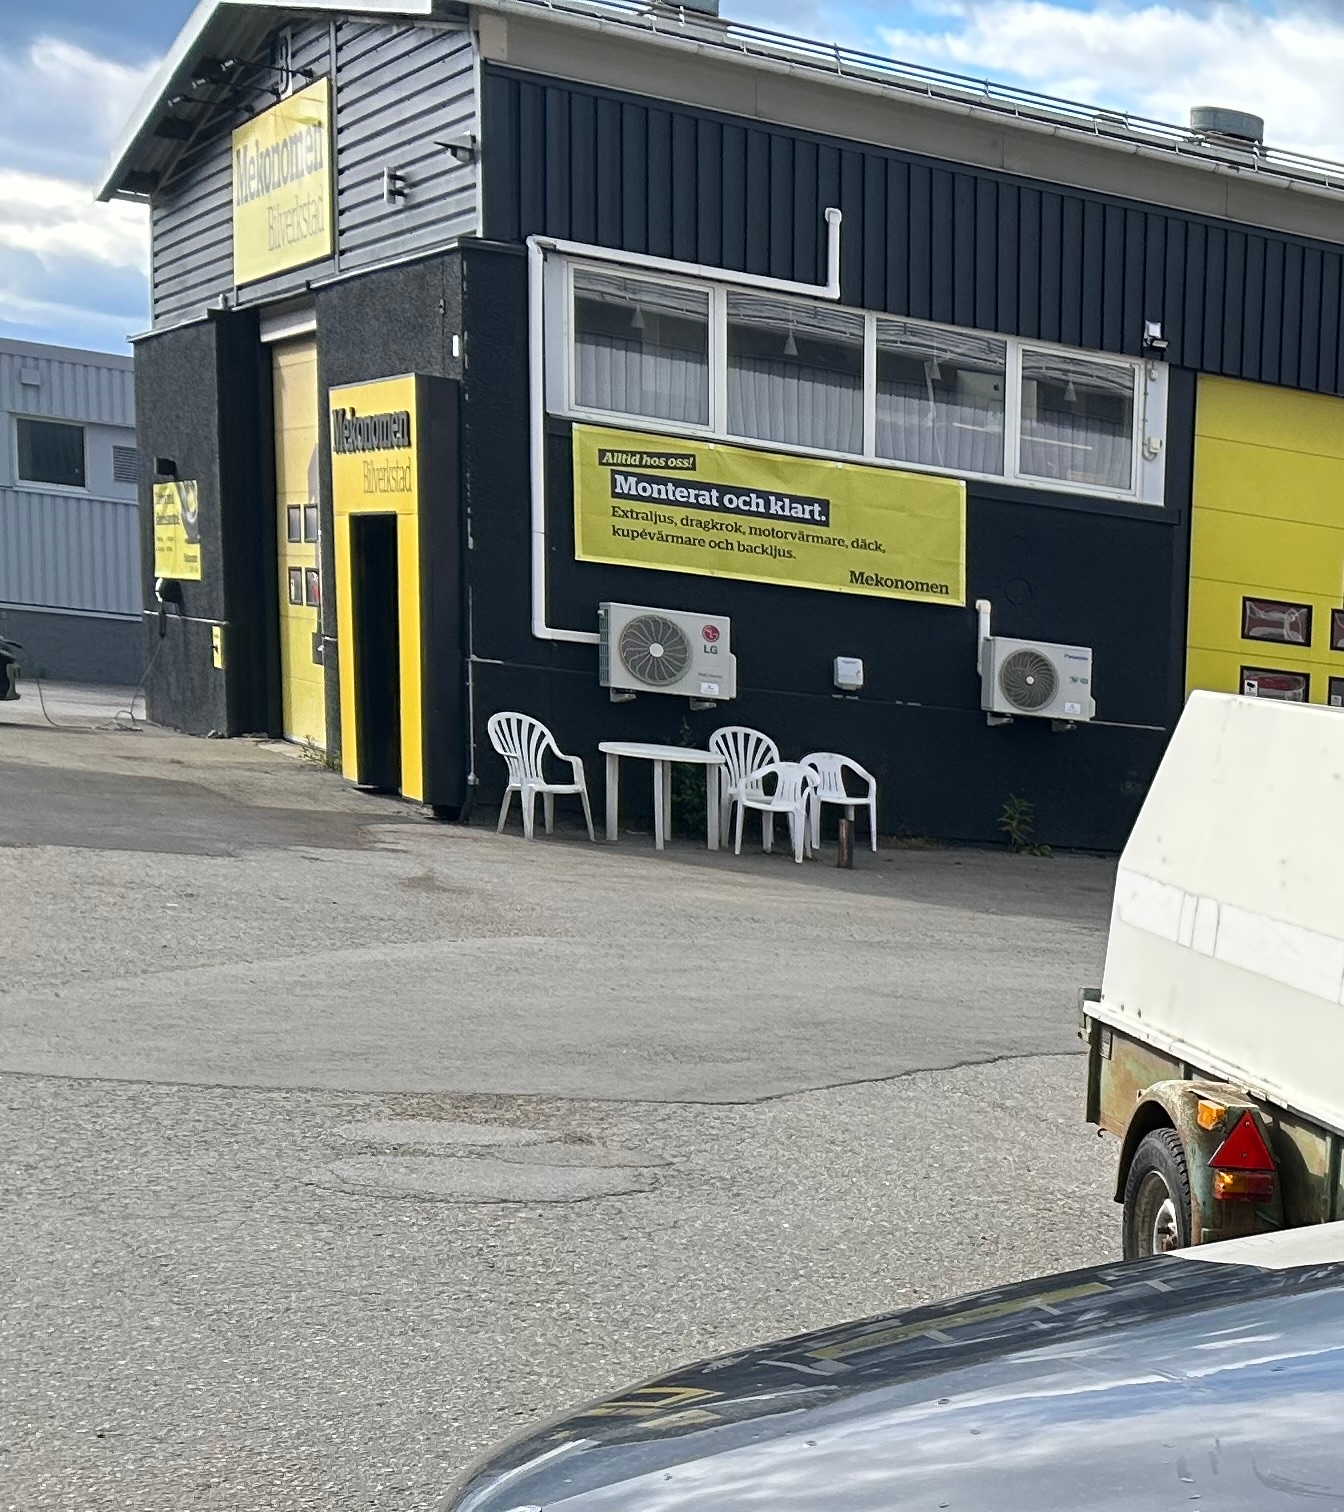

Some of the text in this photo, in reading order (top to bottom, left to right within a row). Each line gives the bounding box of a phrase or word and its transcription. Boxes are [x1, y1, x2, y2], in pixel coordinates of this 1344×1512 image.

[236, 121, 324, 207] Mekonomen
[267, 184, 326, 252] Bilverkstad
[332, 406, 411, 455] Mekonomen
[363, 457, 412, 494] Bilverkstad
[602, 451, 694, 469] Alltid hos oss!
[613, 474, 827, 523] Monterat och klart.
[611, 505, 887, 554] Extraljus, dragkrok, motorvärmare, däck,
[611, 525, 797, 561] kupévärmare och backljus.
[849, 570, 950, 596] Mekonomen
[703, 644, 719, 655] LG
